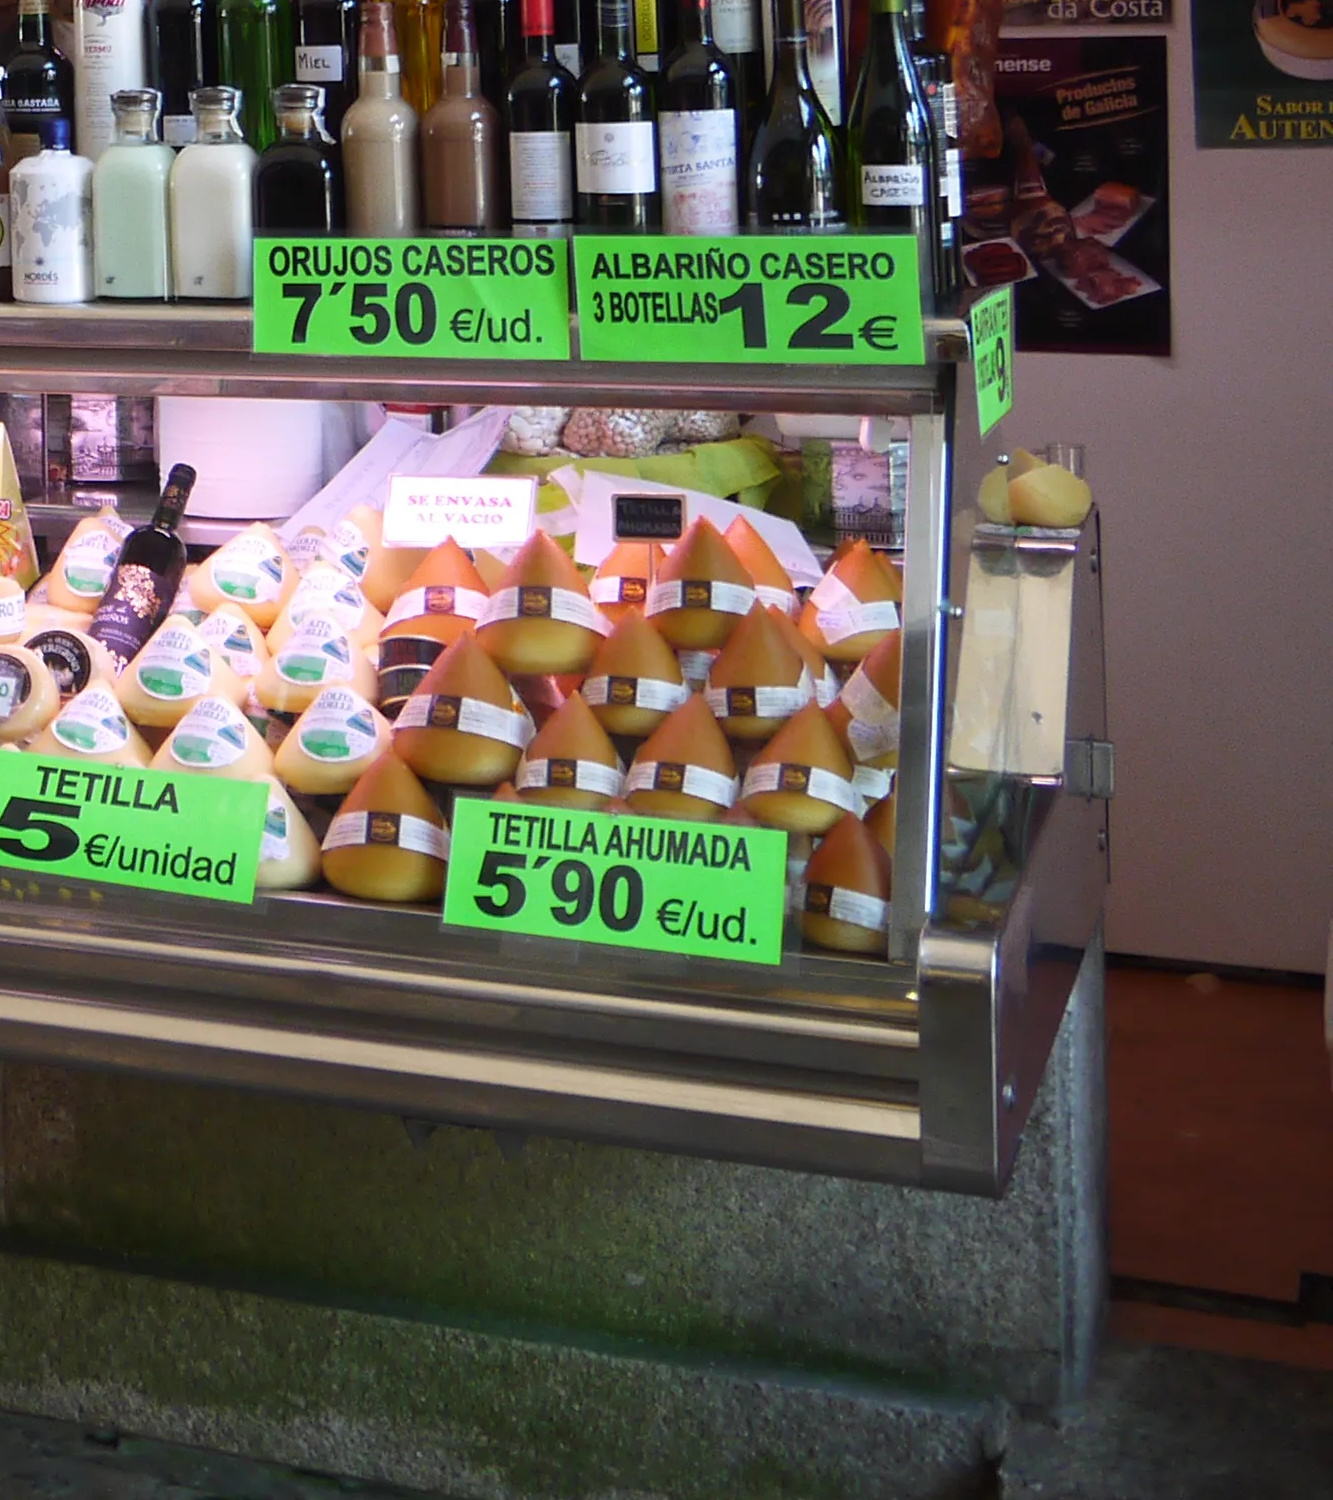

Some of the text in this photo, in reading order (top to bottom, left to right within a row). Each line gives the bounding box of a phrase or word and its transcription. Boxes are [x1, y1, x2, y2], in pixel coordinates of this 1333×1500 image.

[994, 58, 1052, 73] nense
[1056, 77, 1136, 104] Productos
[1257, 93, 1323, 116] SABOR
[1061, 95, 1138, 122] de Galicia
[662, 161, 694, 175] VERTA
[269, 243, 556, 279] ORUJOS CASEROS
[591, 245, 896, 281] ALBARIÑO CASERO
[593, 295, 605, 325] 3
[609, 292, 719, 326] BOTELLAS
[449, 308, 543, 345] €/ud.
[408, 494, 512, 508] SE ENVASA
[445, 513, 503, 525] VACIO
[36, 765, 179, 814] TETILLA
[487, 810, 753, 872] TETILLA AHUMADA
[656, 899, 758, 946] €/ud.
